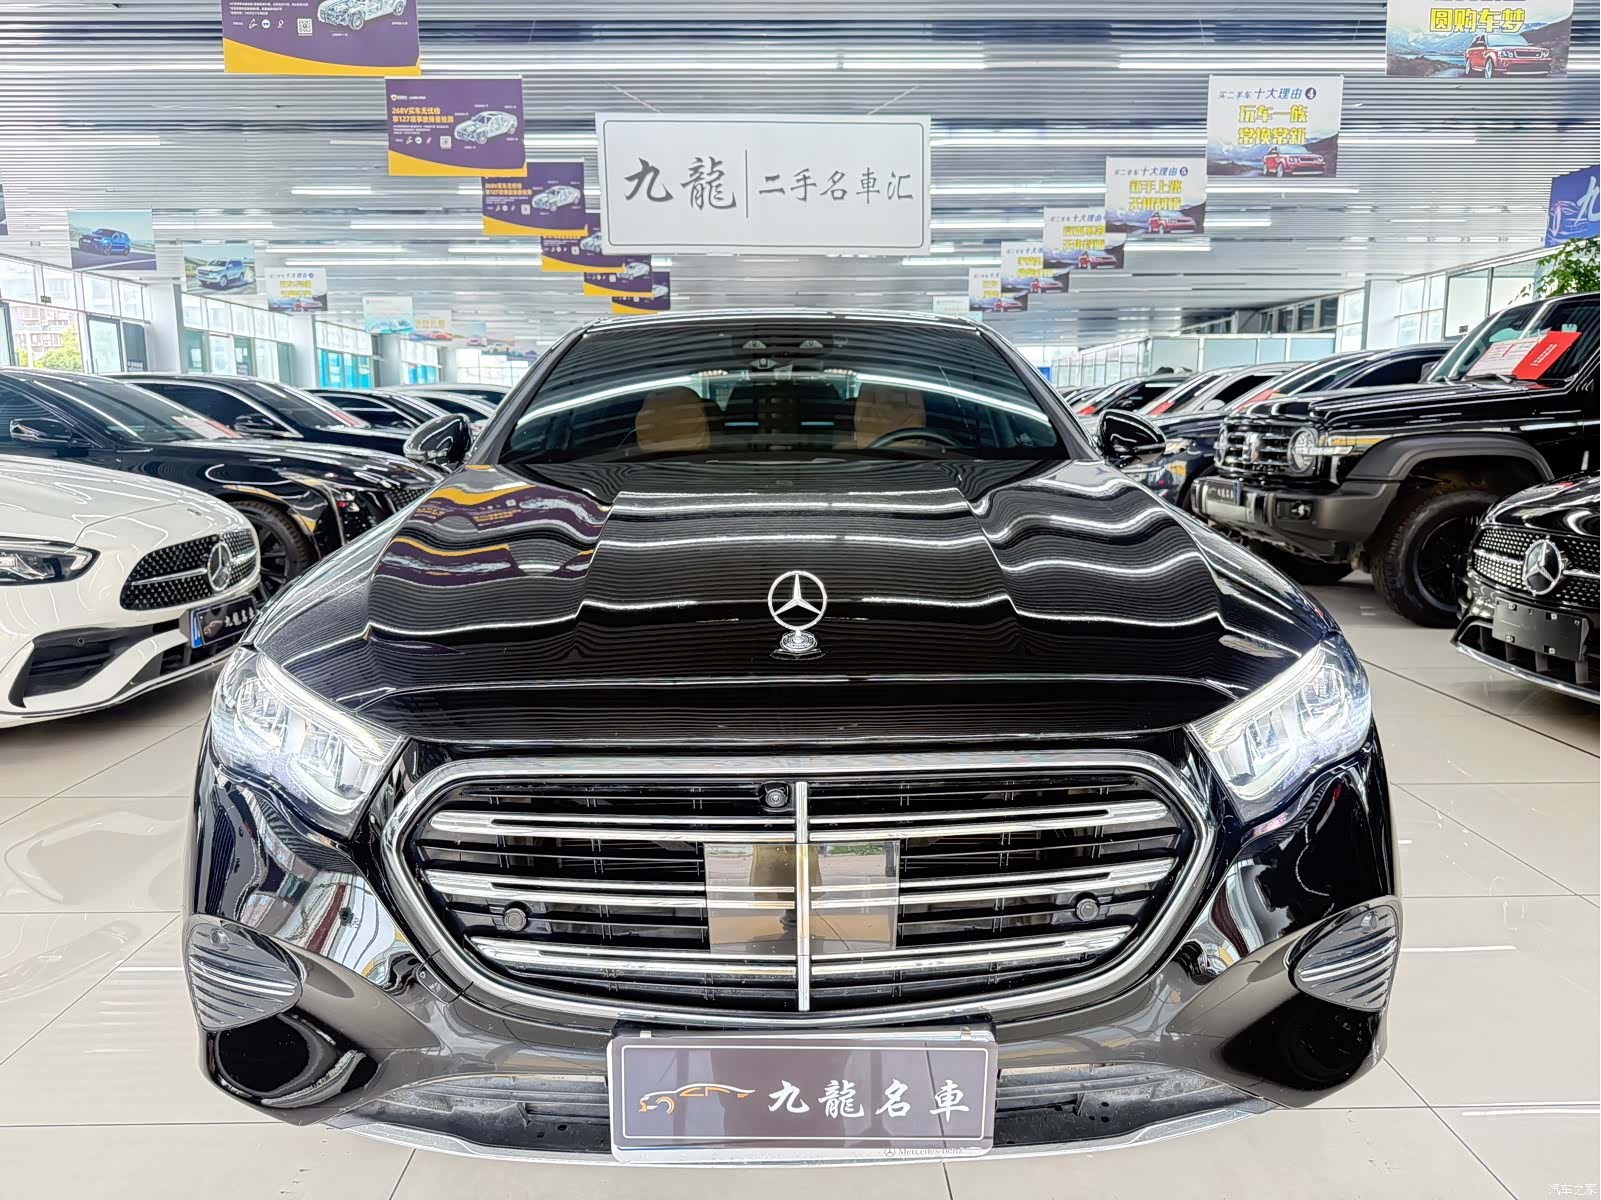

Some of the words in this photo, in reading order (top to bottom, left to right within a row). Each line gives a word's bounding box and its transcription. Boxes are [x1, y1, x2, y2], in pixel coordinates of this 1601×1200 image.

[1430, 8, 1526, 33] 圆购车梦
[1219, 87, 1303, 100] 买二手车十大理由
[1239, 105, 1308, 123] 玩车一族
[1238, 127, 1307, 145] 常换常新
[624, 156, 737, 211] 九龍
[758, 167, 914, 204] 二手名車汇
[1129, 179, 1183, 194] 新手上路
[767, 1079, 970, 1122] 九龍名車
